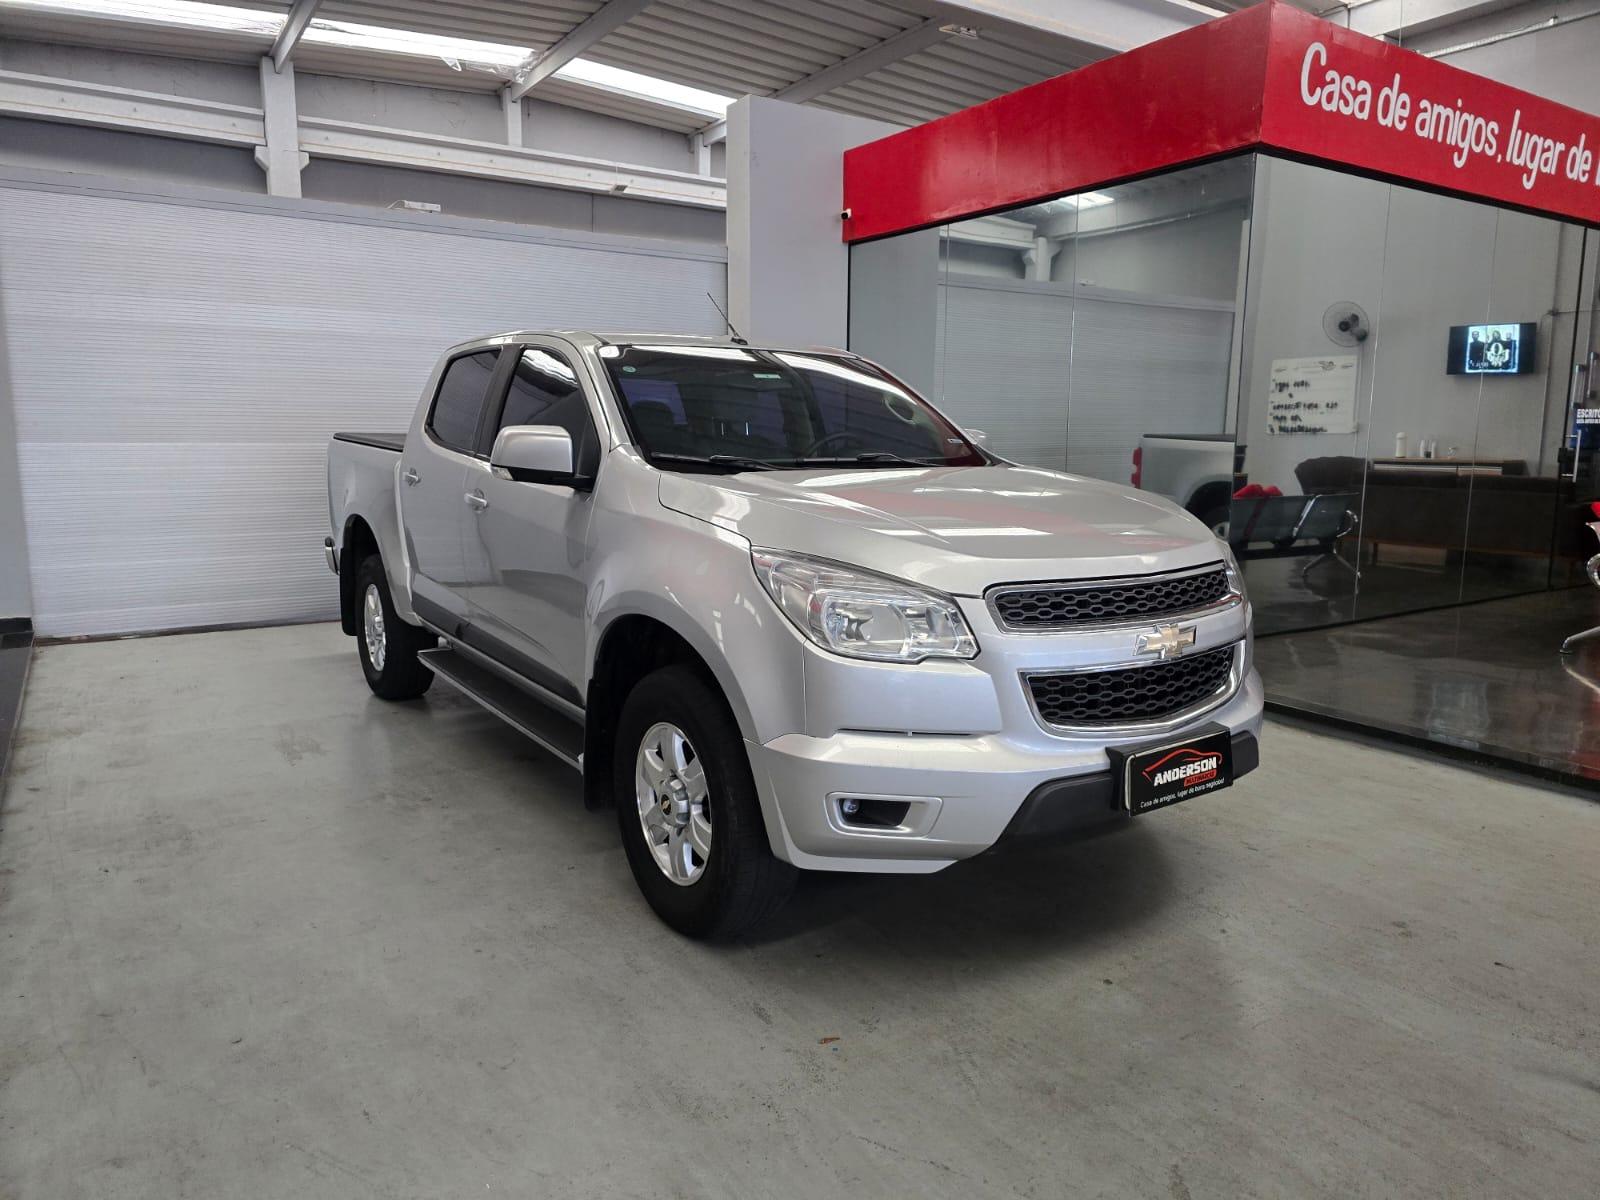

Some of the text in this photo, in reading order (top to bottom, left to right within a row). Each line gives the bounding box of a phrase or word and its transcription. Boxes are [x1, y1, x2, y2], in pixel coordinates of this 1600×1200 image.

[1300, 41, 1372, 121] Casa
[1377, 73, 1411, 131] de
[1415, 98, 1502, 169] amigos,
[1506, 108, 1566, 190] lugar
[1565, 133, 1593, 183] de
[1153, 757, 1217, 787] ANDERSON
[1140, 800, 1153, 808] Casa
